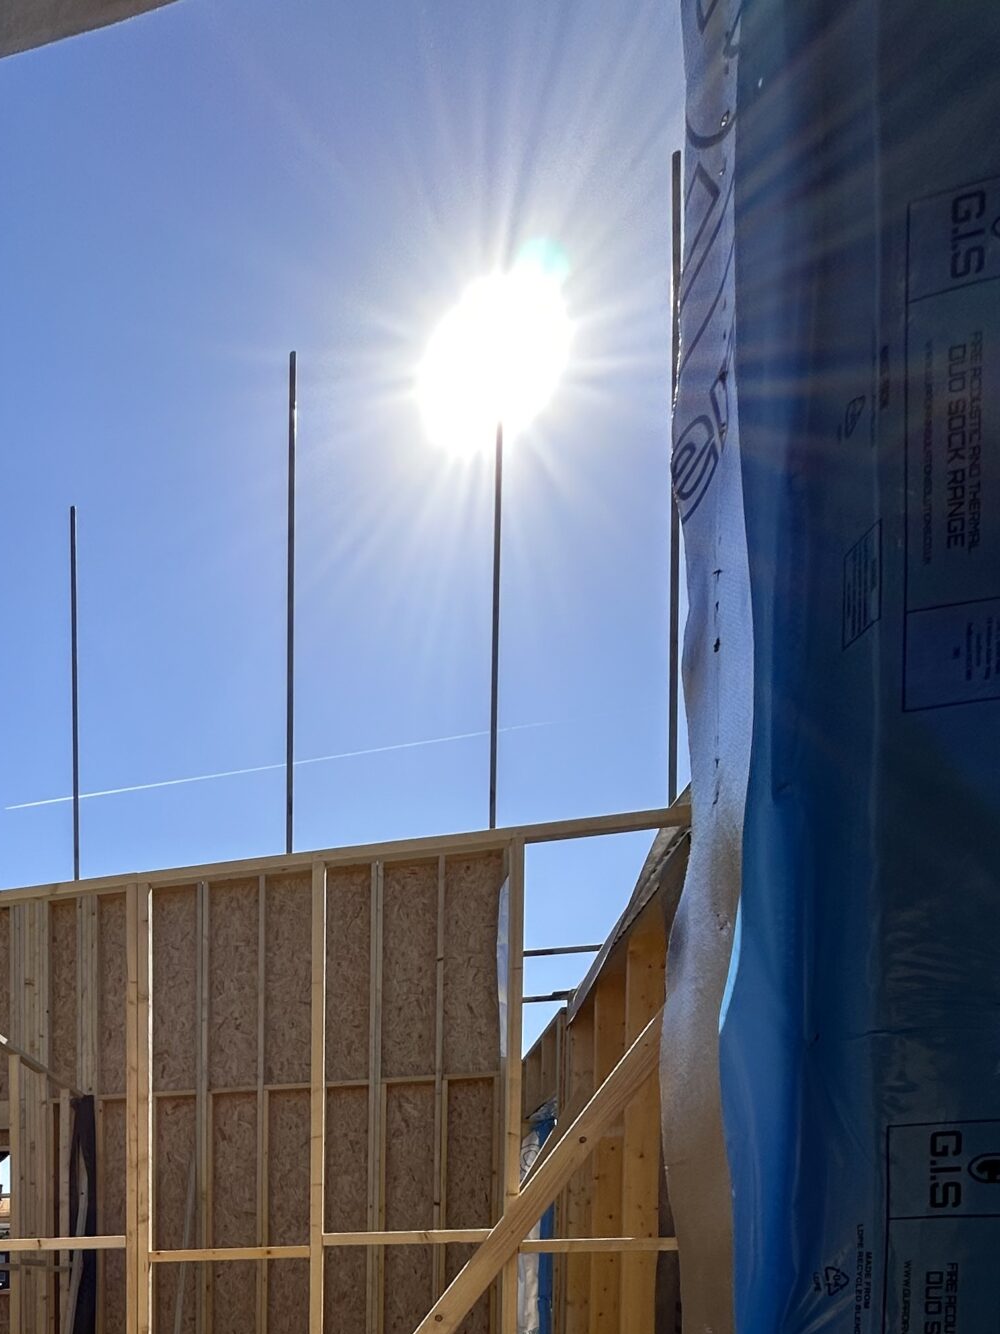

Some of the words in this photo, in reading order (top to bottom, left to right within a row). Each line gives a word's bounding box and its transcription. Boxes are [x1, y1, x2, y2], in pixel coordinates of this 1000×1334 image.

[947, 399, 966, 464] SOCK
[946, 470, 965, 549] RANGE
[930, 1130, 963, 1208] G.I.S
[924, 1270, 944, 1315] DUO
